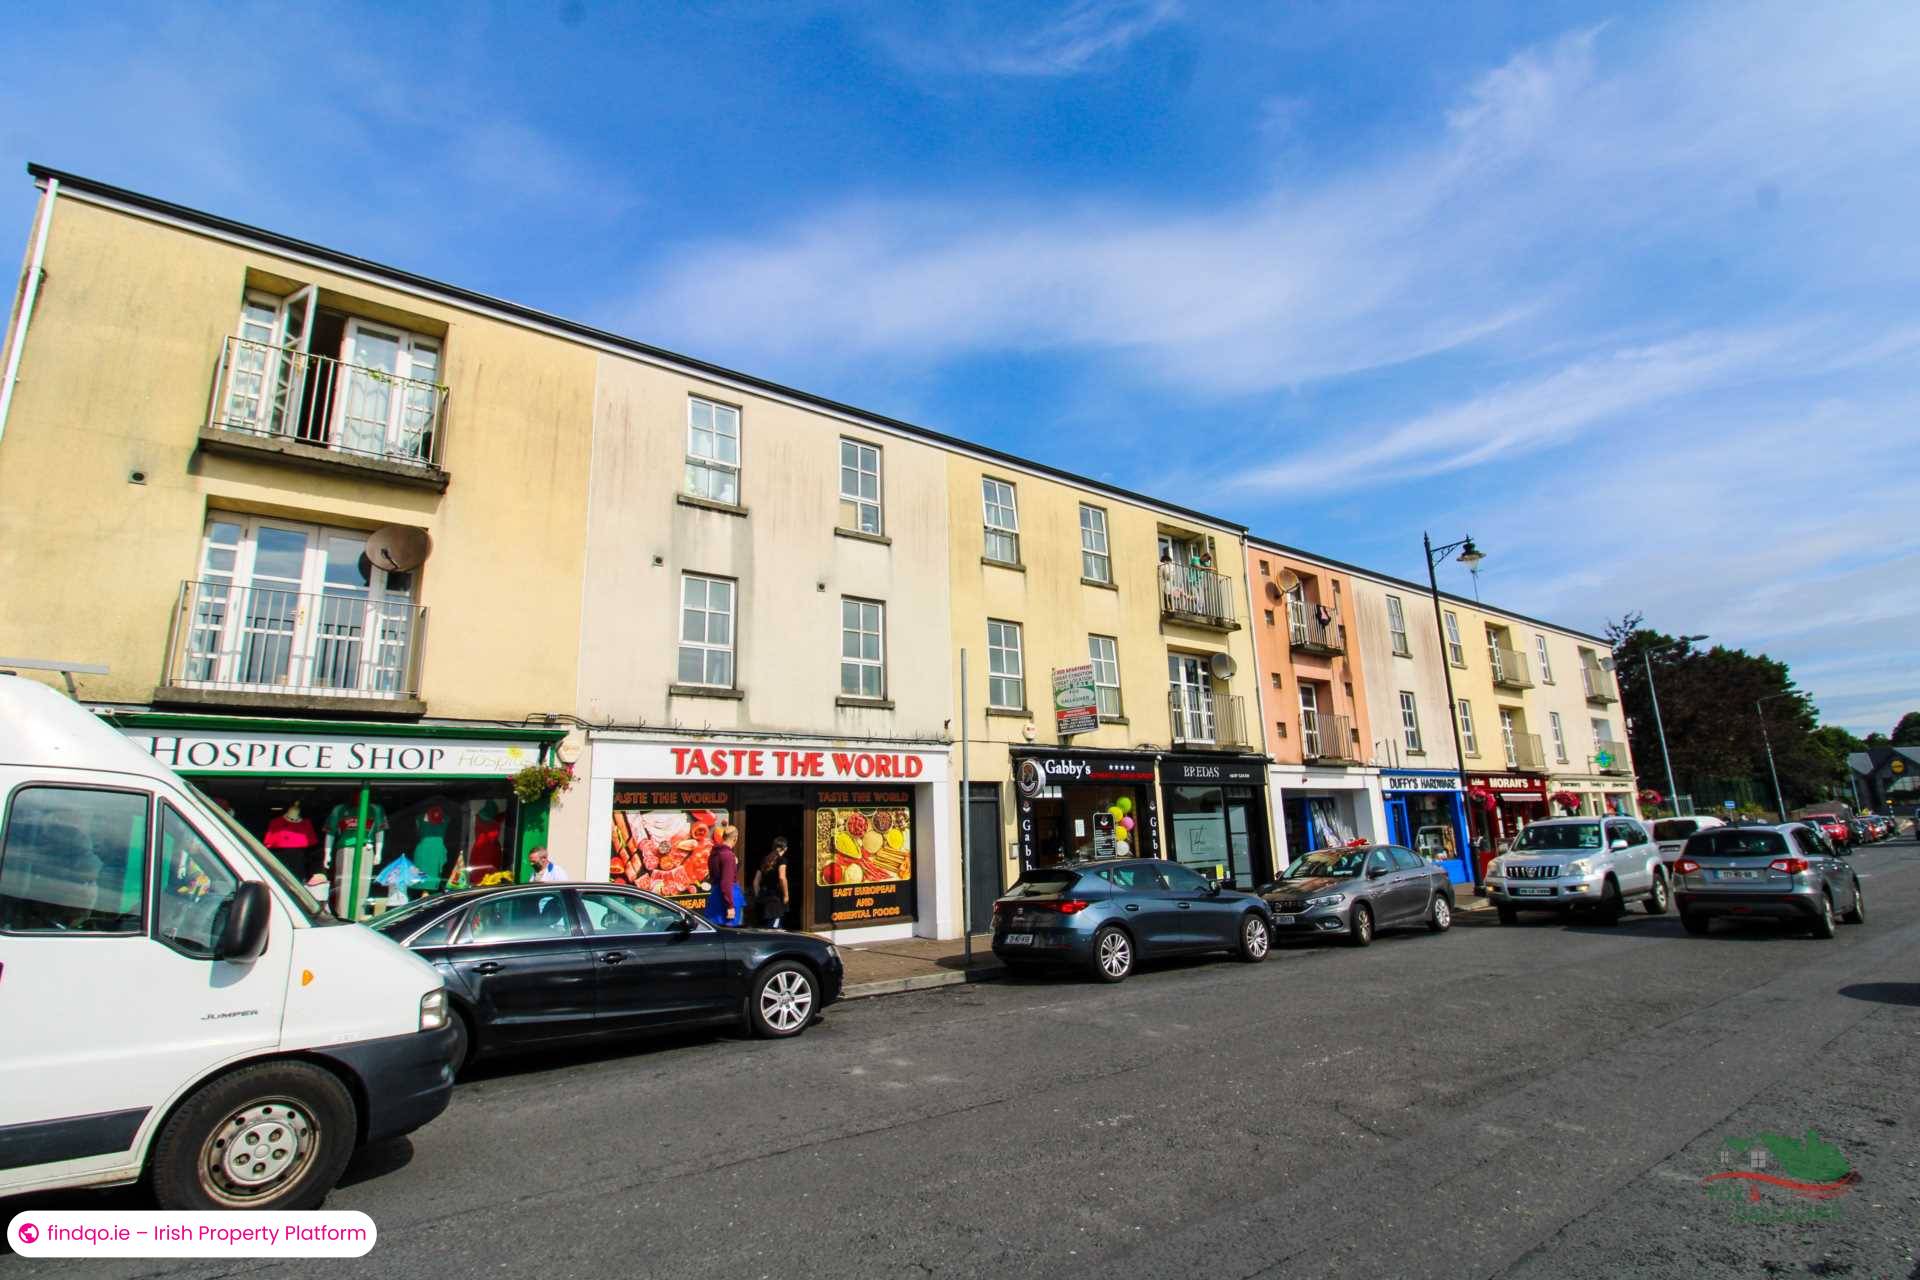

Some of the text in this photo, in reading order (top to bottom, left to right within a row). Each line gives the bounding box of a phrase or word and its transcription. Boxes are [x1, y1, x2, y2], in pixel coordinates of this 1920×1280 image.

[151, 737, 444, 770] HOSPICE SHOP
[671, 748, 923, 778] TASTE THE WORLD
[1045, 759, 1091, 778] Gabby's
[1184, 765, 1220, 778] BREDAS
[1389, 777, 1456, 789] DUFFY'S HARDWARE
[614, 791, 728, 804] ASTE THE WORLD
[817, 791, 909, 802] TASTE THE WORLD
[832, 885, 896, 897] EAST EUROPEAN
[856, 898, 874, 907] AND
[832, 906, 900, 920] ORIENTAL FOODS
[200, 1009, 258, 1020] JUMPER
